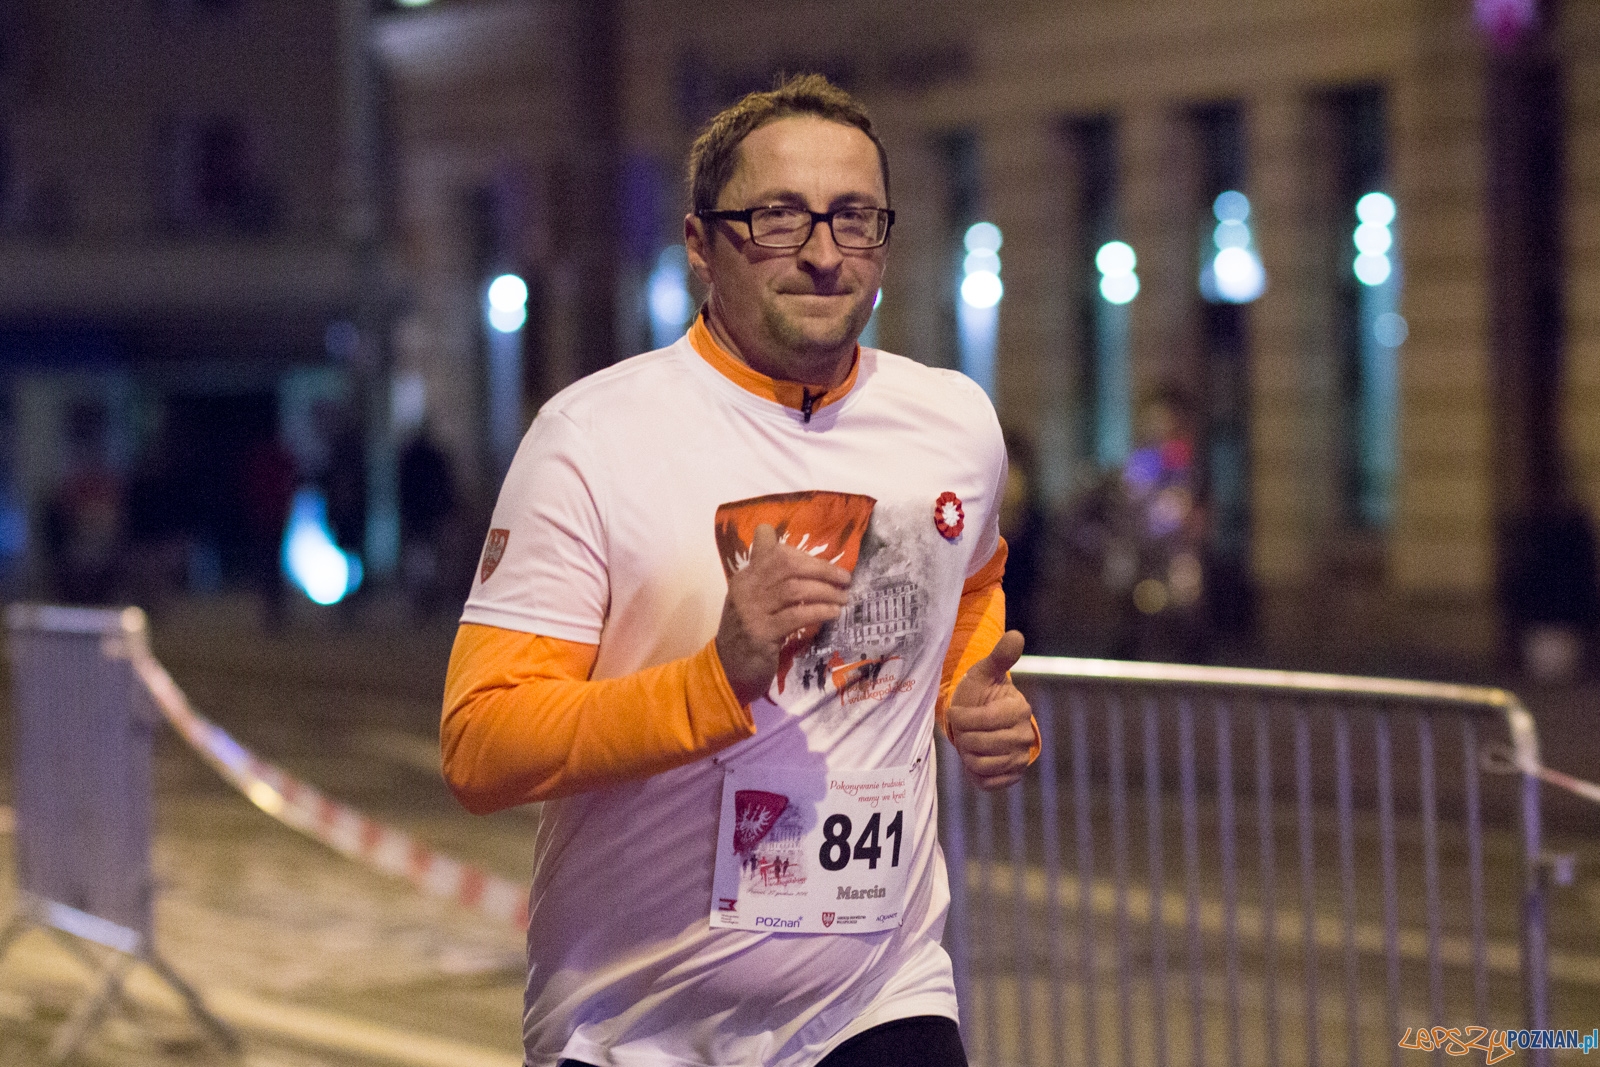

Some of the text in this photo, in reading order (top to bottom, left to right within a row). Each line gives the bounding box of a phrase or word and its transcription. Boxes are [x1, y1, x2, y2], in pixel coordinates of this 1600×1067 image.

[830, 780, 880, 796] Pokonywanie
[858, 795, 880, 808] mamy
[819, 810, 903, 871] 841
[836, 885, 886, 900] Marcin
